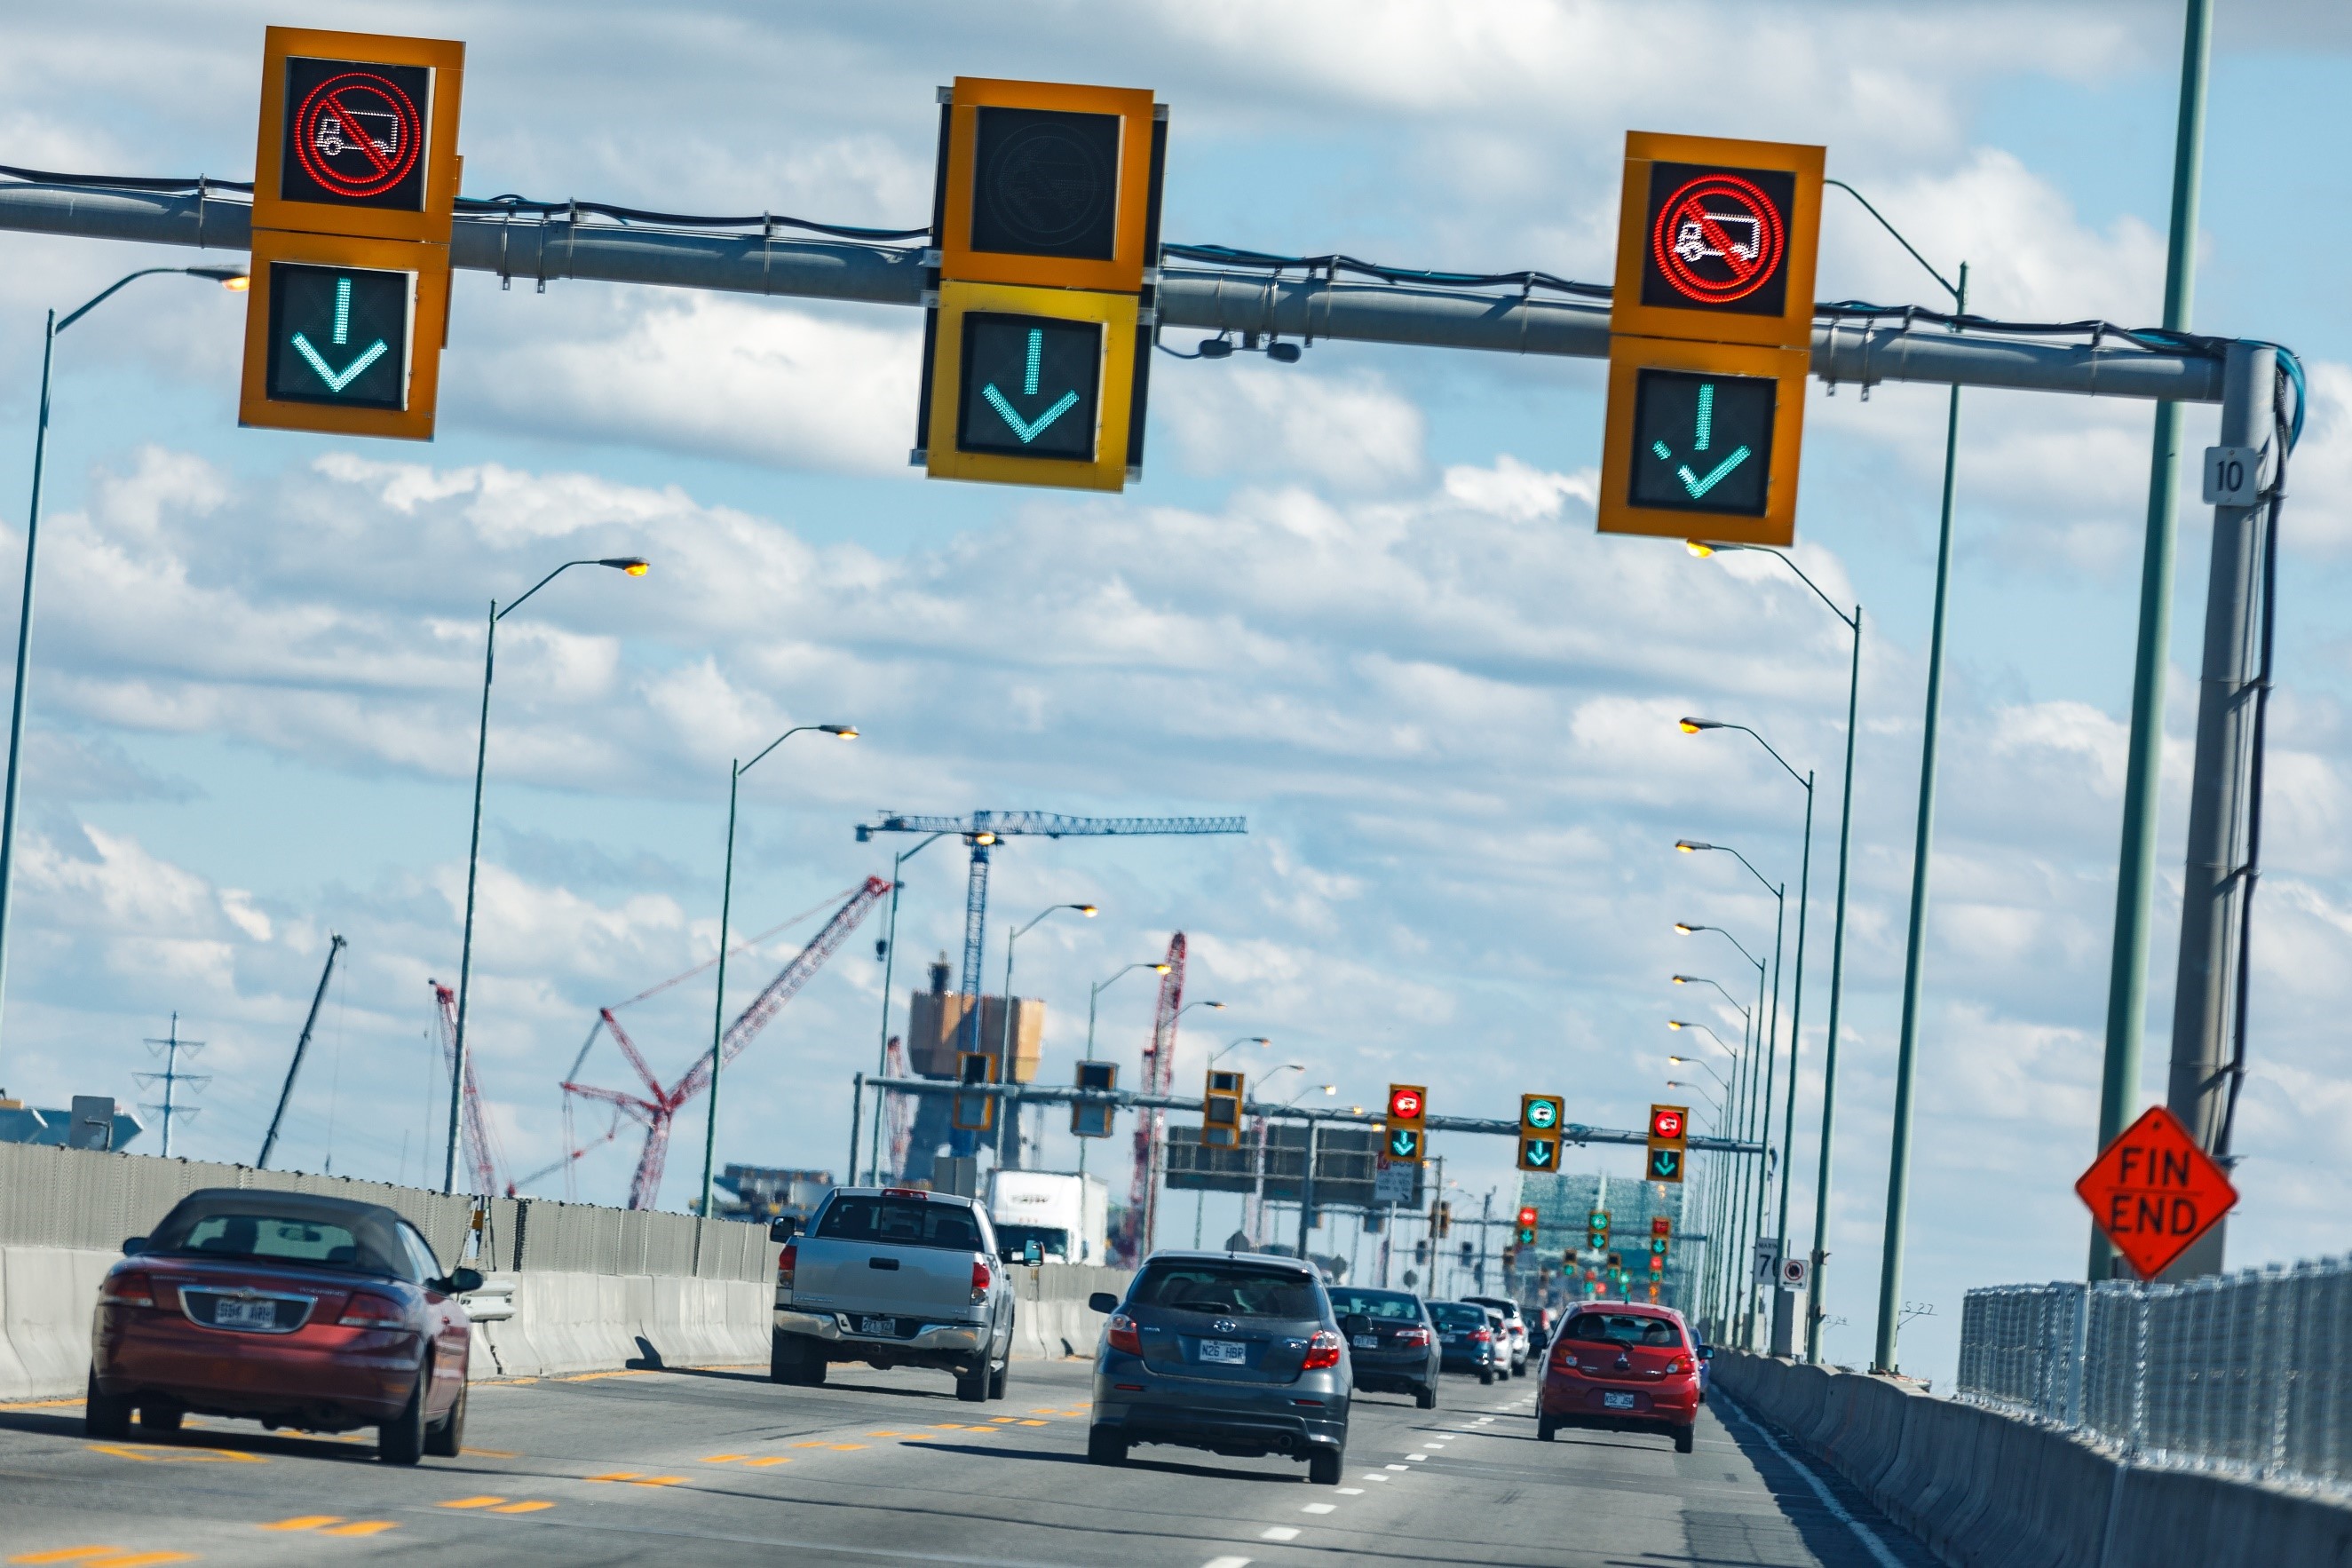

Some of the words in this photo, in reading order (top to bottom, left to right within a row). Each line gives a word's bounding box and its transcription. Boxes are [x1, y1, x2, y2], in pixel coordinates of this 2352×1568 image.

[2215, 460, 2245, 493] 10
[2118, 1146, 2190, 1189] FIN
[2109, 1194, 2198, 1236] END
[1919, 1303, 1934, 1315] 27
[1201, 1344, 1220, 1357] N26
[1225, 1346, 1244, 1360] HBR
